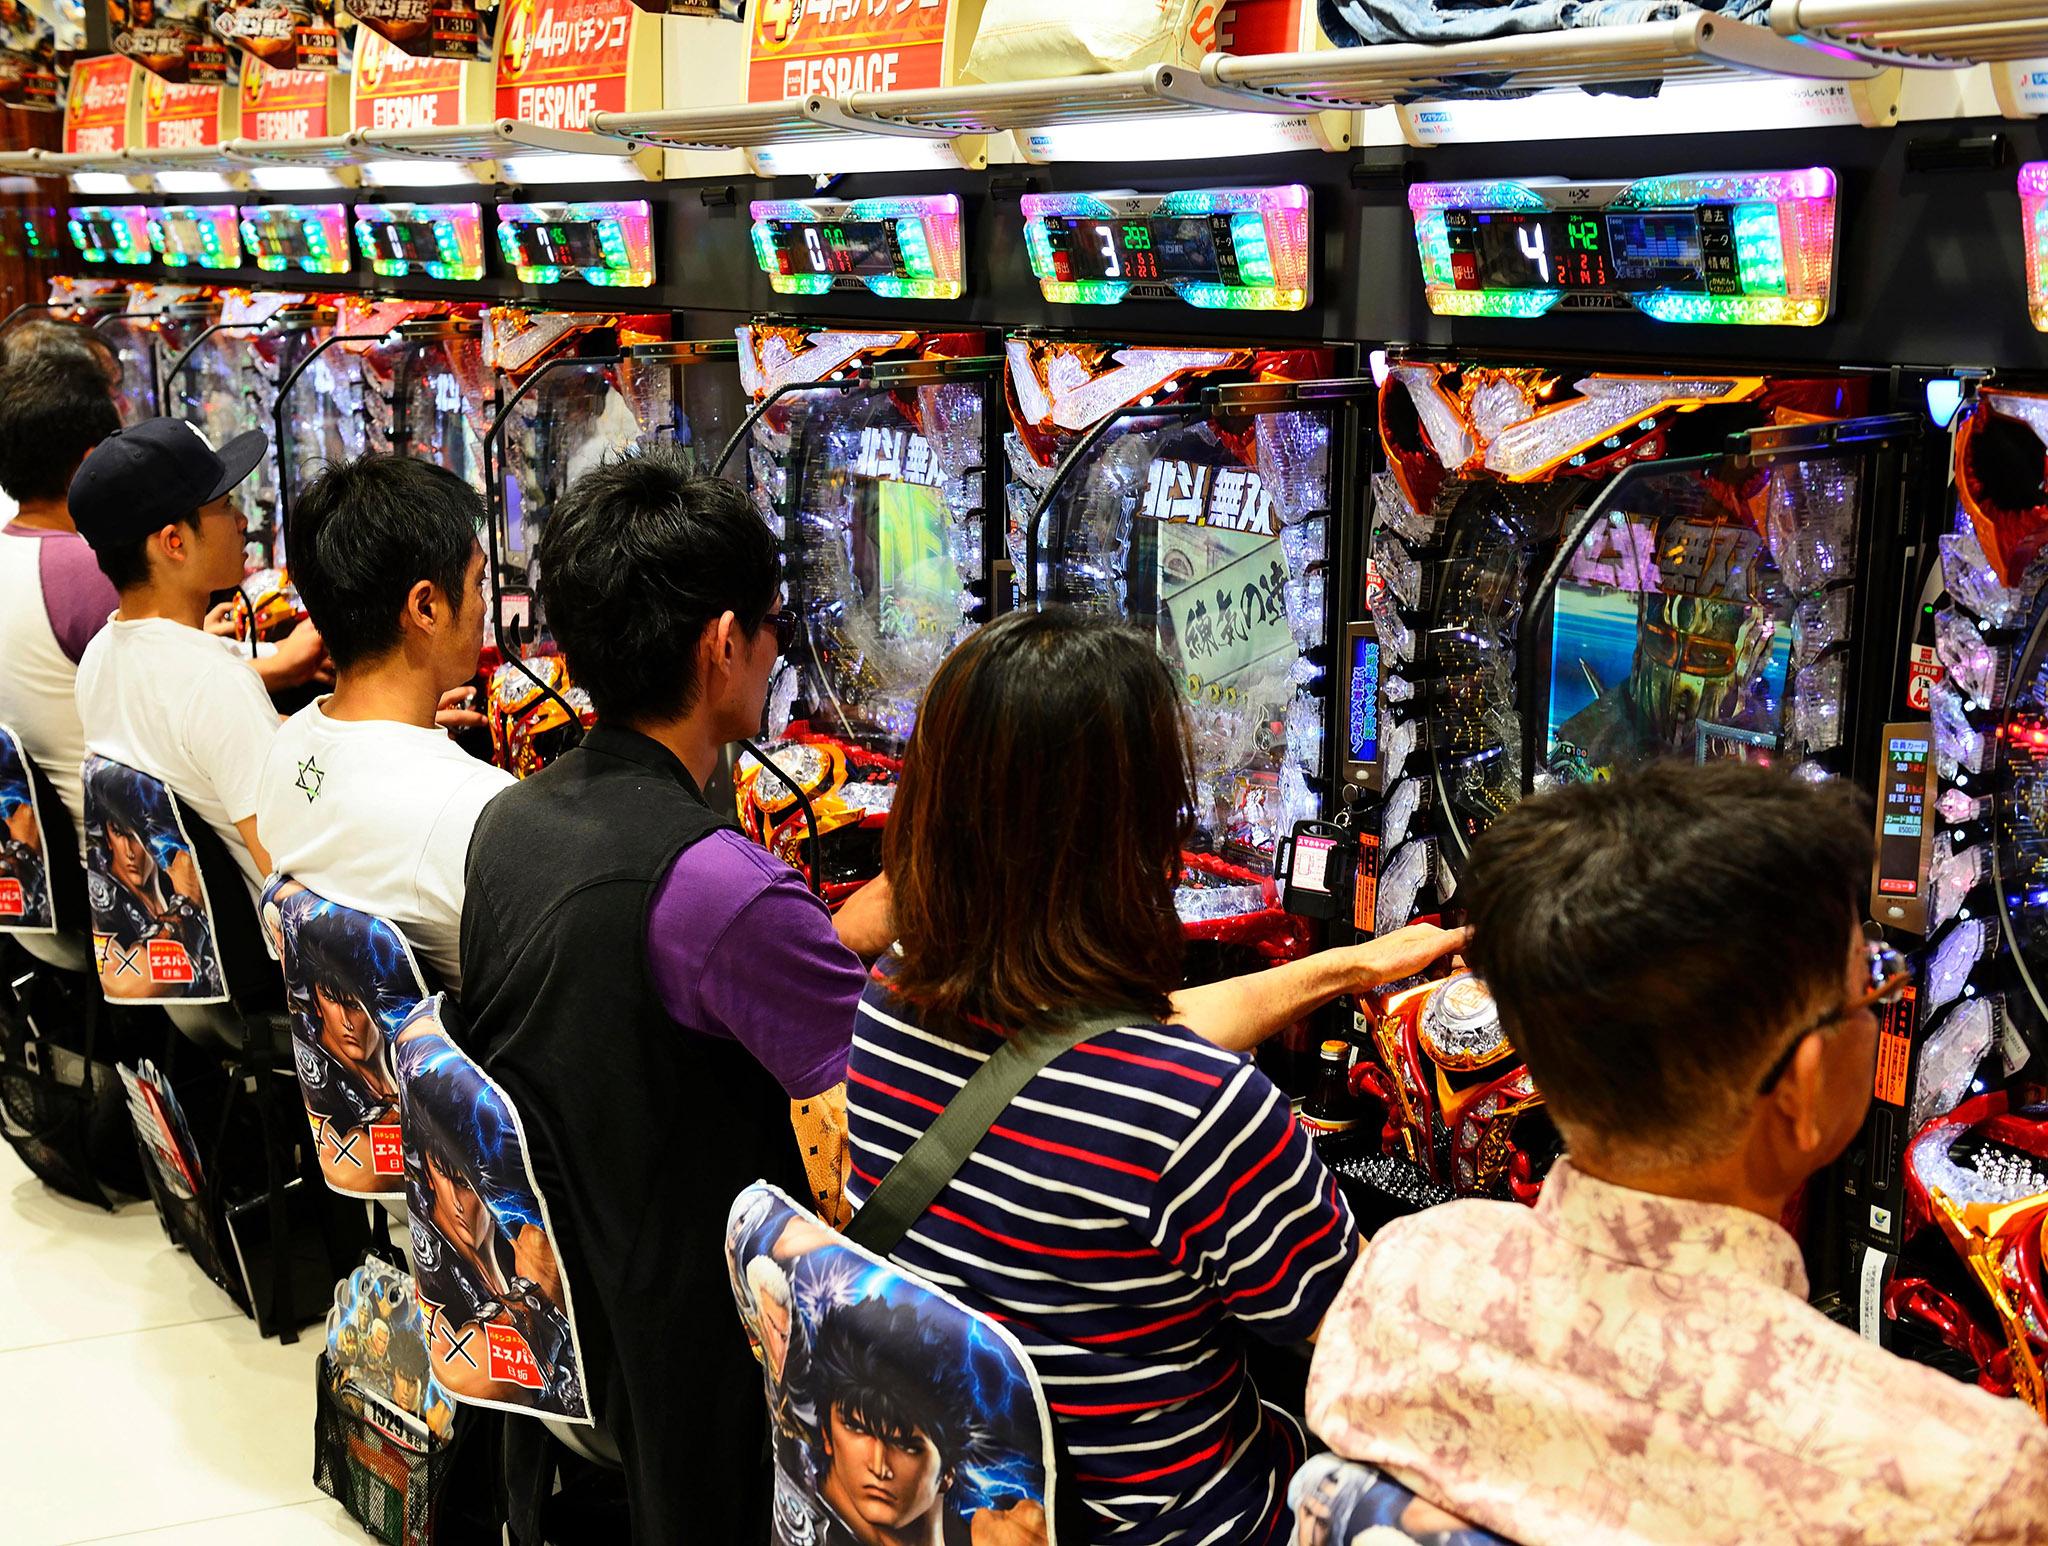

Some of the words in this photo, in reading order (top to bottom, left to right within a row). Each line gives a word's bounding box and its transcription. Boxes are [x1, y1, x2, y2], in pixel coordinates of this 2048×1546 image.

[439, 17, 474, 32] 1/319
[301, 34, 335, 47] 1/319
[534, 8, 627, 58] 4円パチンコ
[807, 52, 900, 100] ESPACE
[533, 82, 597, 130] ESPACE
[1702, 209, 1726, 224] 過去
[1703, 233, 1730, 247] データ
[803, 227, 827, 272] 0
[1094, 225, 1121, 278] 3
[1121, 225, 1151, 250] 293
[1517, 221, 1552, 284] 4
[1567, 221, 1599, 251] 142
[1708, 255, 1731, 271] 情報
[1452, 265, 1477, 281] 呼出
[1584, 297, 1609, 307] 1327
[1891, 740, 1927, 750] 会員カード
[371, 1400, 404, 1438] 1329
